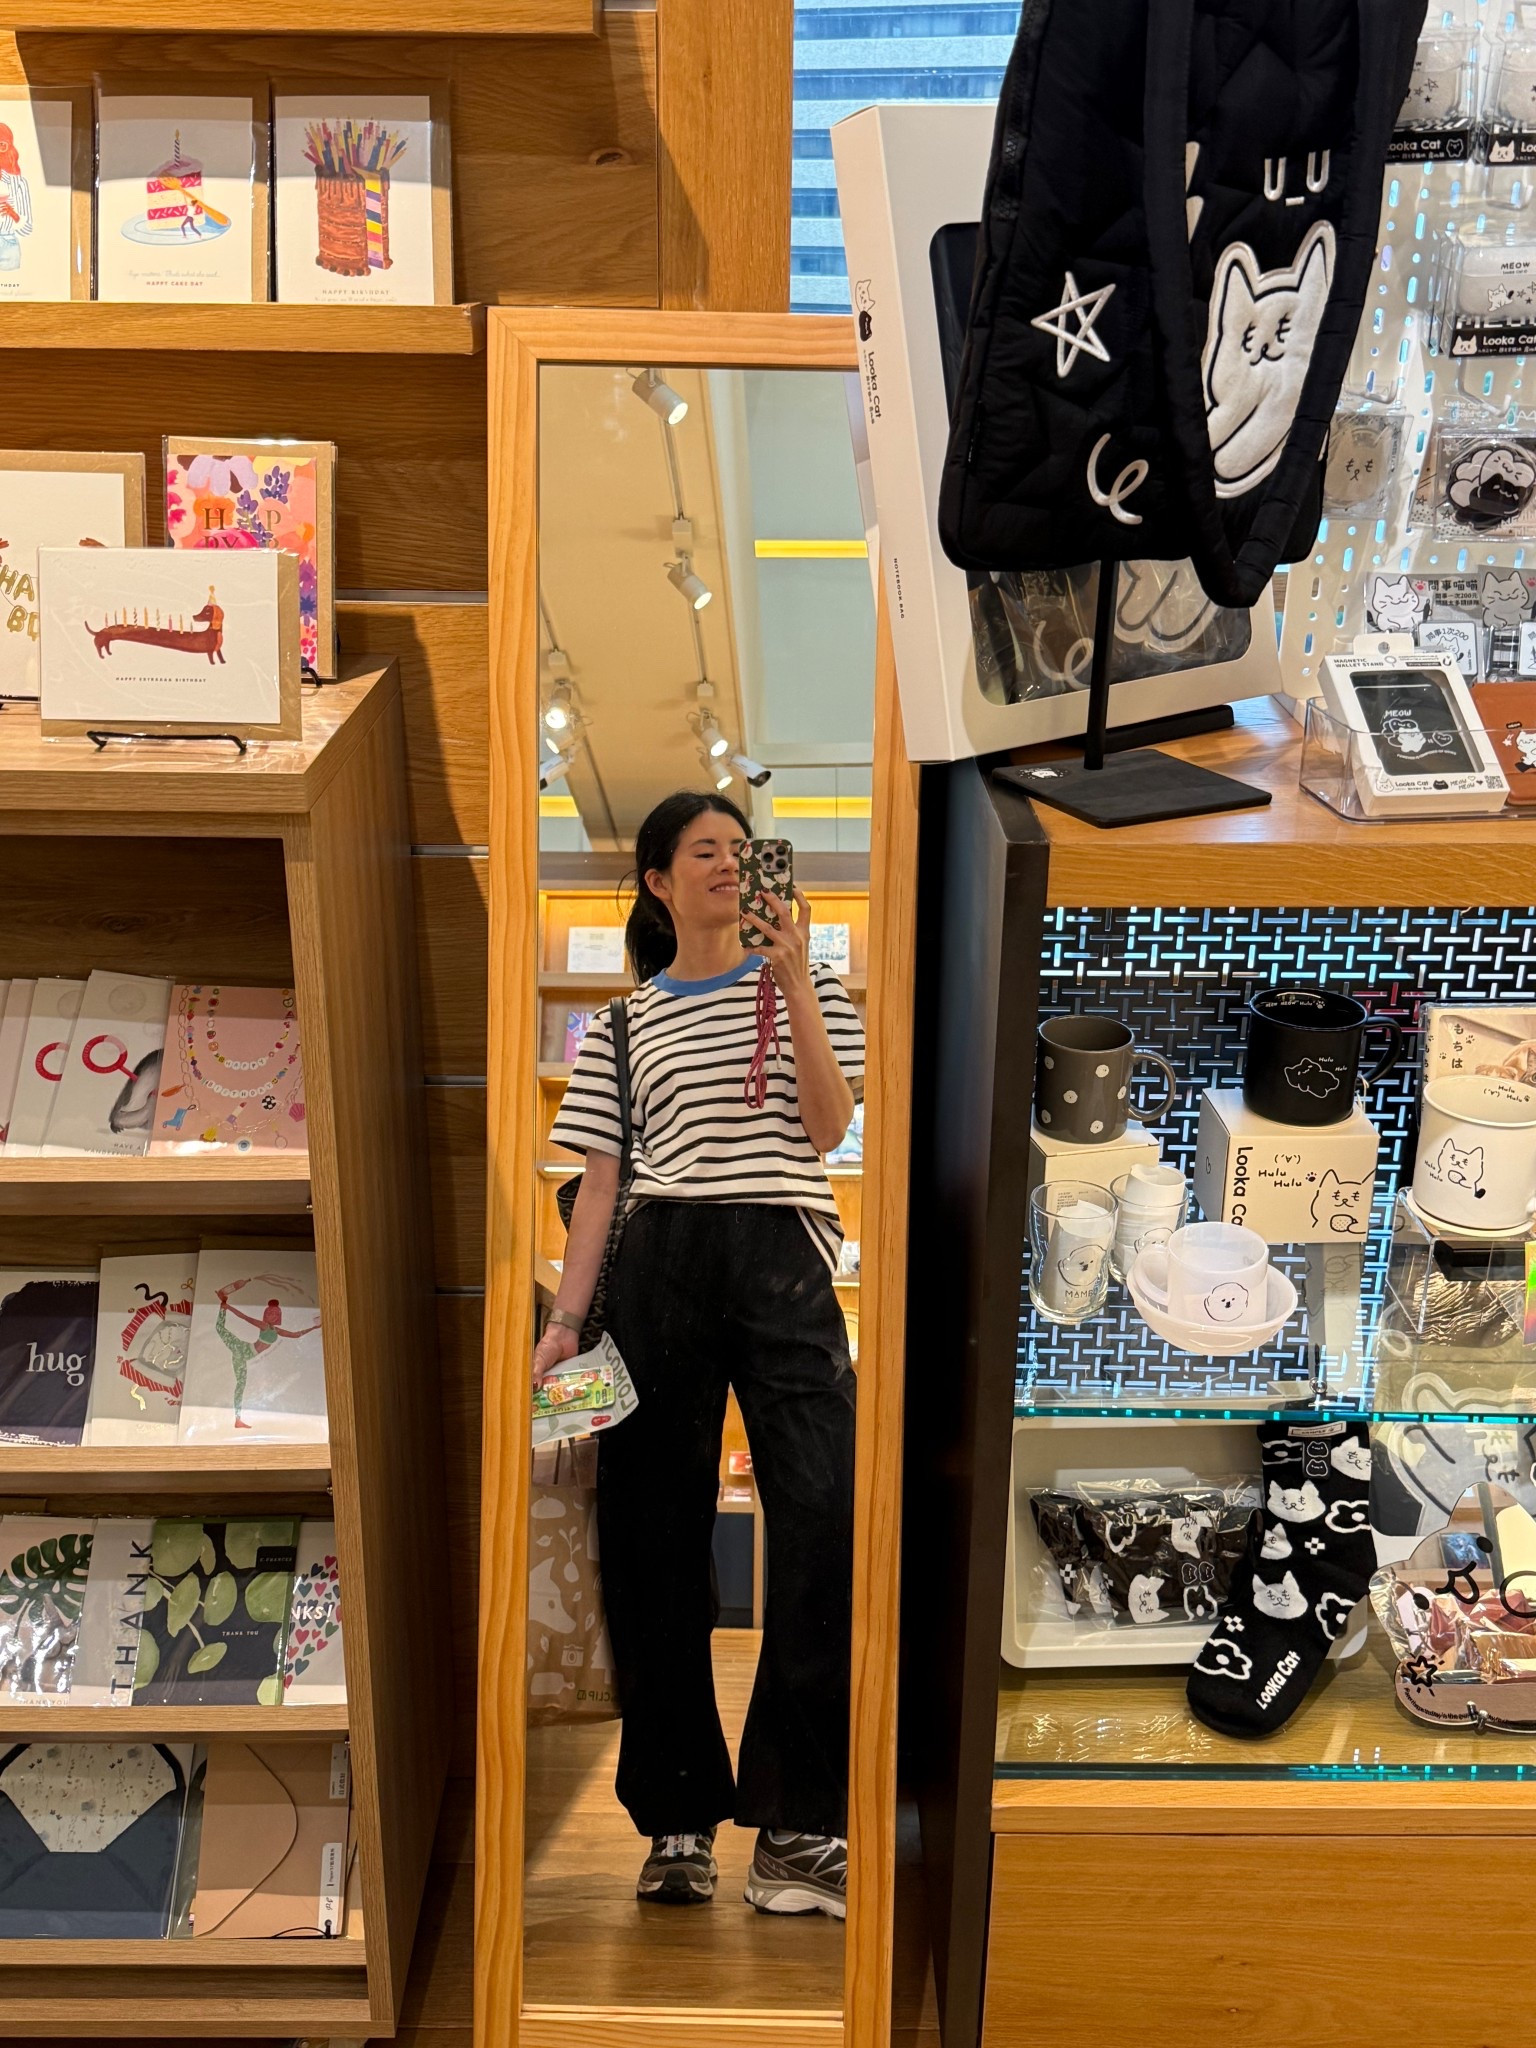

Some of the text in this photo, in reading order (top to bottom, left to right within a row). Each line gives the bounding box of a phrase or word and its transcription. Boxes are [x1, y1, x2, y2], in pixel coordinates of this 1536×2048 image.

[1387, 139, 1441, 151] ooka Cat
[1501, 261, 1530, 270] MEOW
[1483, 336, 1515, 346] Looka
[868, 351, 877, 391] Looka
[873, 395, 881, 418] Cat
[893, 557, 902, 601] NOTEBOOK
[1385, 709, 1412, 717] MEOW
[1452, 1024, 1464, 1069] もちは
[224, 1058, 266, 1070] HAPPY
[1498, 1085, 1516, 1094] Hulu
[1506, 1094, 1523, 1103] Hulu
[1424, 1160, 1436, 1170] Hulu
[1232, 1146, 1254, 1197] Looka
[1258, 1168, 1287, 1178] Hulu
[1429, 1172, 1443, 1182] Hulu
[1273, 1178, 1303, 1188] Hulu
[26, 1342, 86, 1387] hug
[110, 1540, 153, 1694] THANK
[1277, 1650, 1301, 1676] Cat
